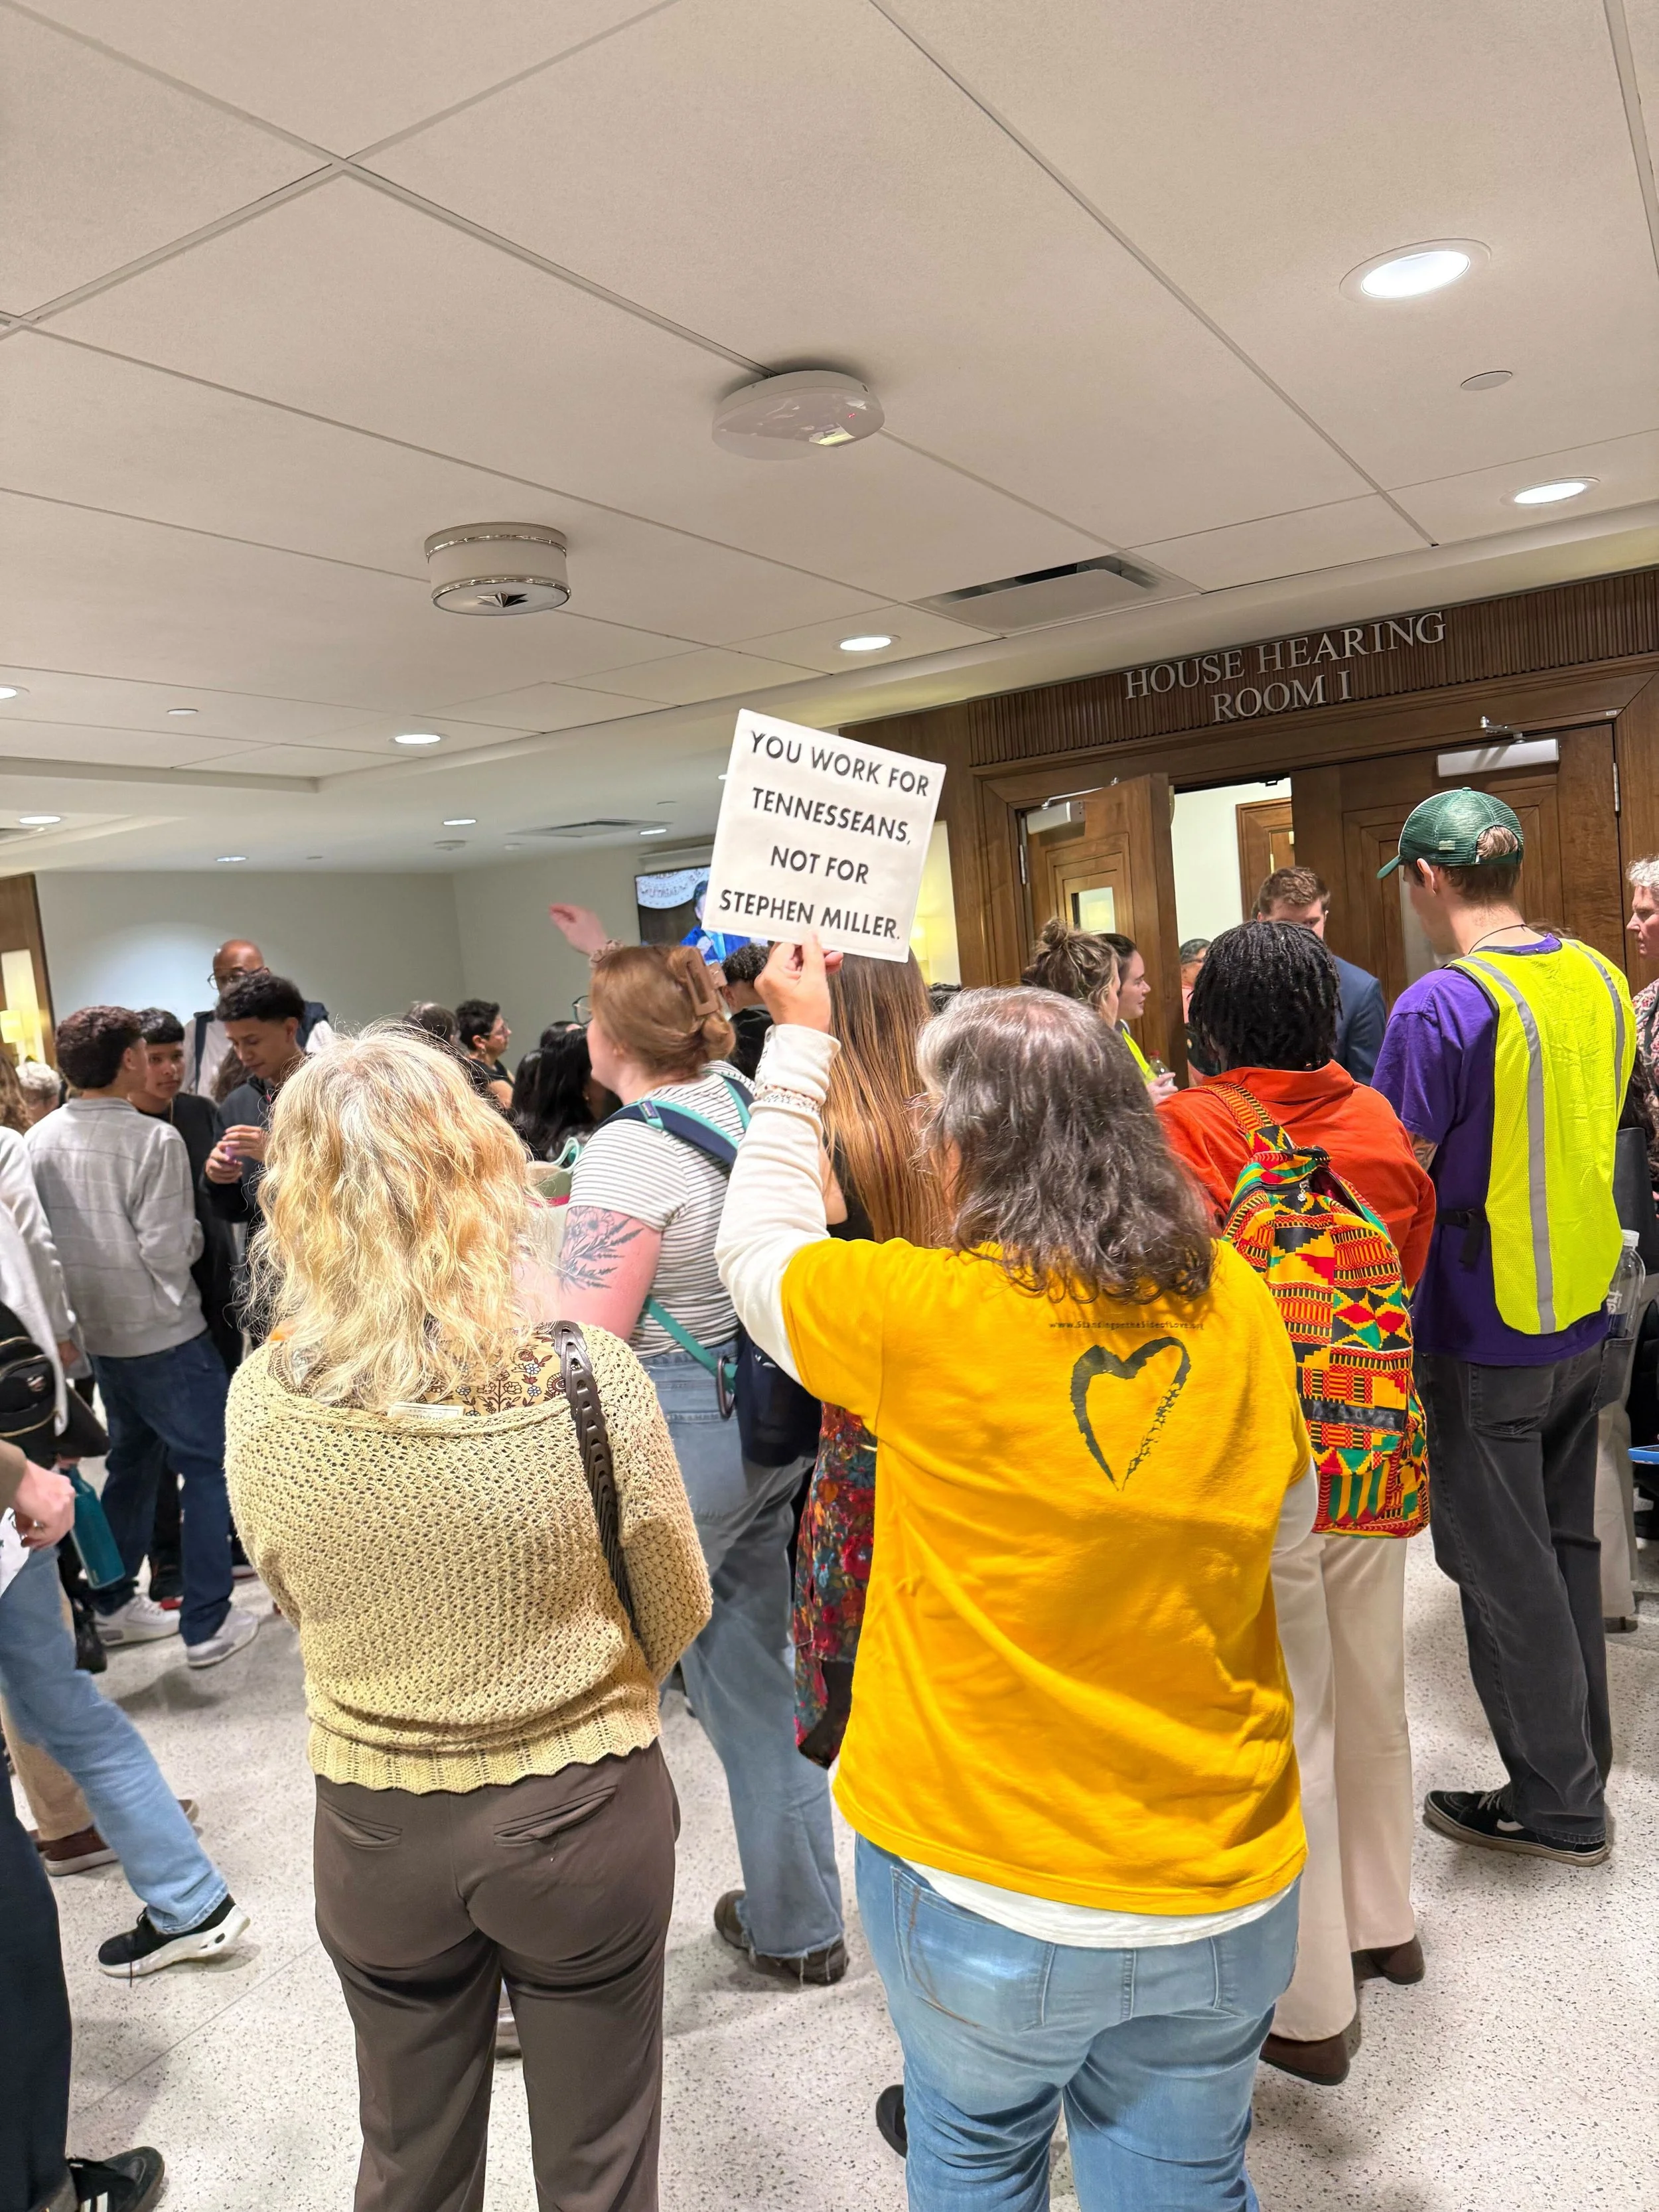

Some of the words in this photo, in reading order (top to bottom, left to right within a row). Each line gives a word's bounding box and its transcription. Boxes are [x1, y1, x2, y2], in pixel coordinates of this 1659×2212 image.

[1123, 650, 1245, 700] HOUSE
[1255, 611, 1447, 675] HEARING
[1210, 674, 1327, 723] ROOM
[1336, 670, 1352, 701] I
[751, 731, 802, 764] YOU
[811, 746, 883, 785] WORK
[888, 768, 929, 797] FOR
[752, 787, 912, 846] TENNESSEANS,
[770, 846, 821, 875] NOT
[825, 857, 869, 885] FOR
[719, 889, 815, 925] STEPHEN
[820, 907, 901, 940] MILLER.
